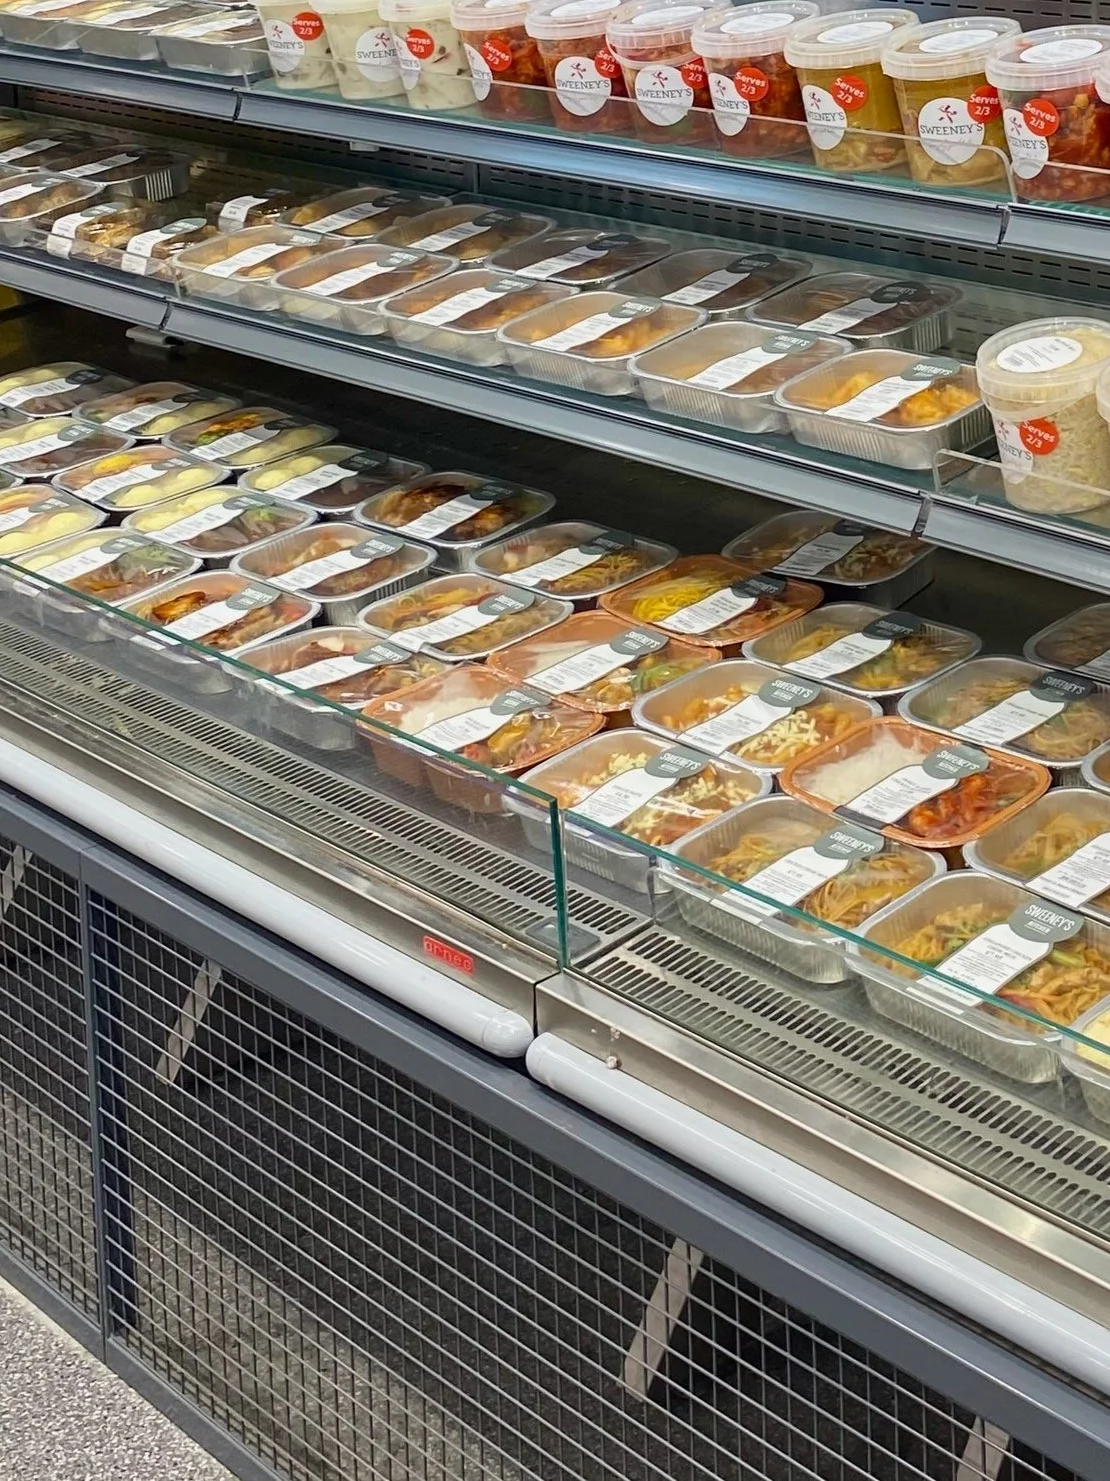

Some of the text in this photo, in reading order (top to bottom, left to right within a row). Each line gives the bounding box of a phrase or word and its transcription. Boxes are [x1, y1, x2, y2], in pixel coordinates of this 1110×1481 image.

[300, 27, 313, 36] 2/3
[356, 48, 396, 59] SWEENE
[411, 43, 425, 53] 2/3
[483, 42, 510, 62] Serves
[487, 53, 500, 65] 2/3
[599, 50, 618, 64] Serv
[600, 62, 615, 73] 2/3
[683, 62, 706, 72] Serv
[689, 72, 702, 83] 2/3
[735, 71, 766, 87] Serves
[556, 78, 611, 90] SWEENEY'S
[740, 83, 756, 95] 2/3
[834, 77, 865, 99] Serves
[637, 88, 692, 99] SWEENEY'S
[836, 91, 853, 104] 2/3
[968, 93, 1000, 106] Serves
[975, 106, 990, 117] 2/3
[1025, 104, 1056, 124] Serves
[919, 122, 983, 136] SWEENEY'S
[1029, 117, 1045, 129] 2/3
[1022, 420, 1056, 443] Serves
[1025, 435, 1043, 449] 2/3
[1024, 904, 1075, 932] SWEENEY'S
